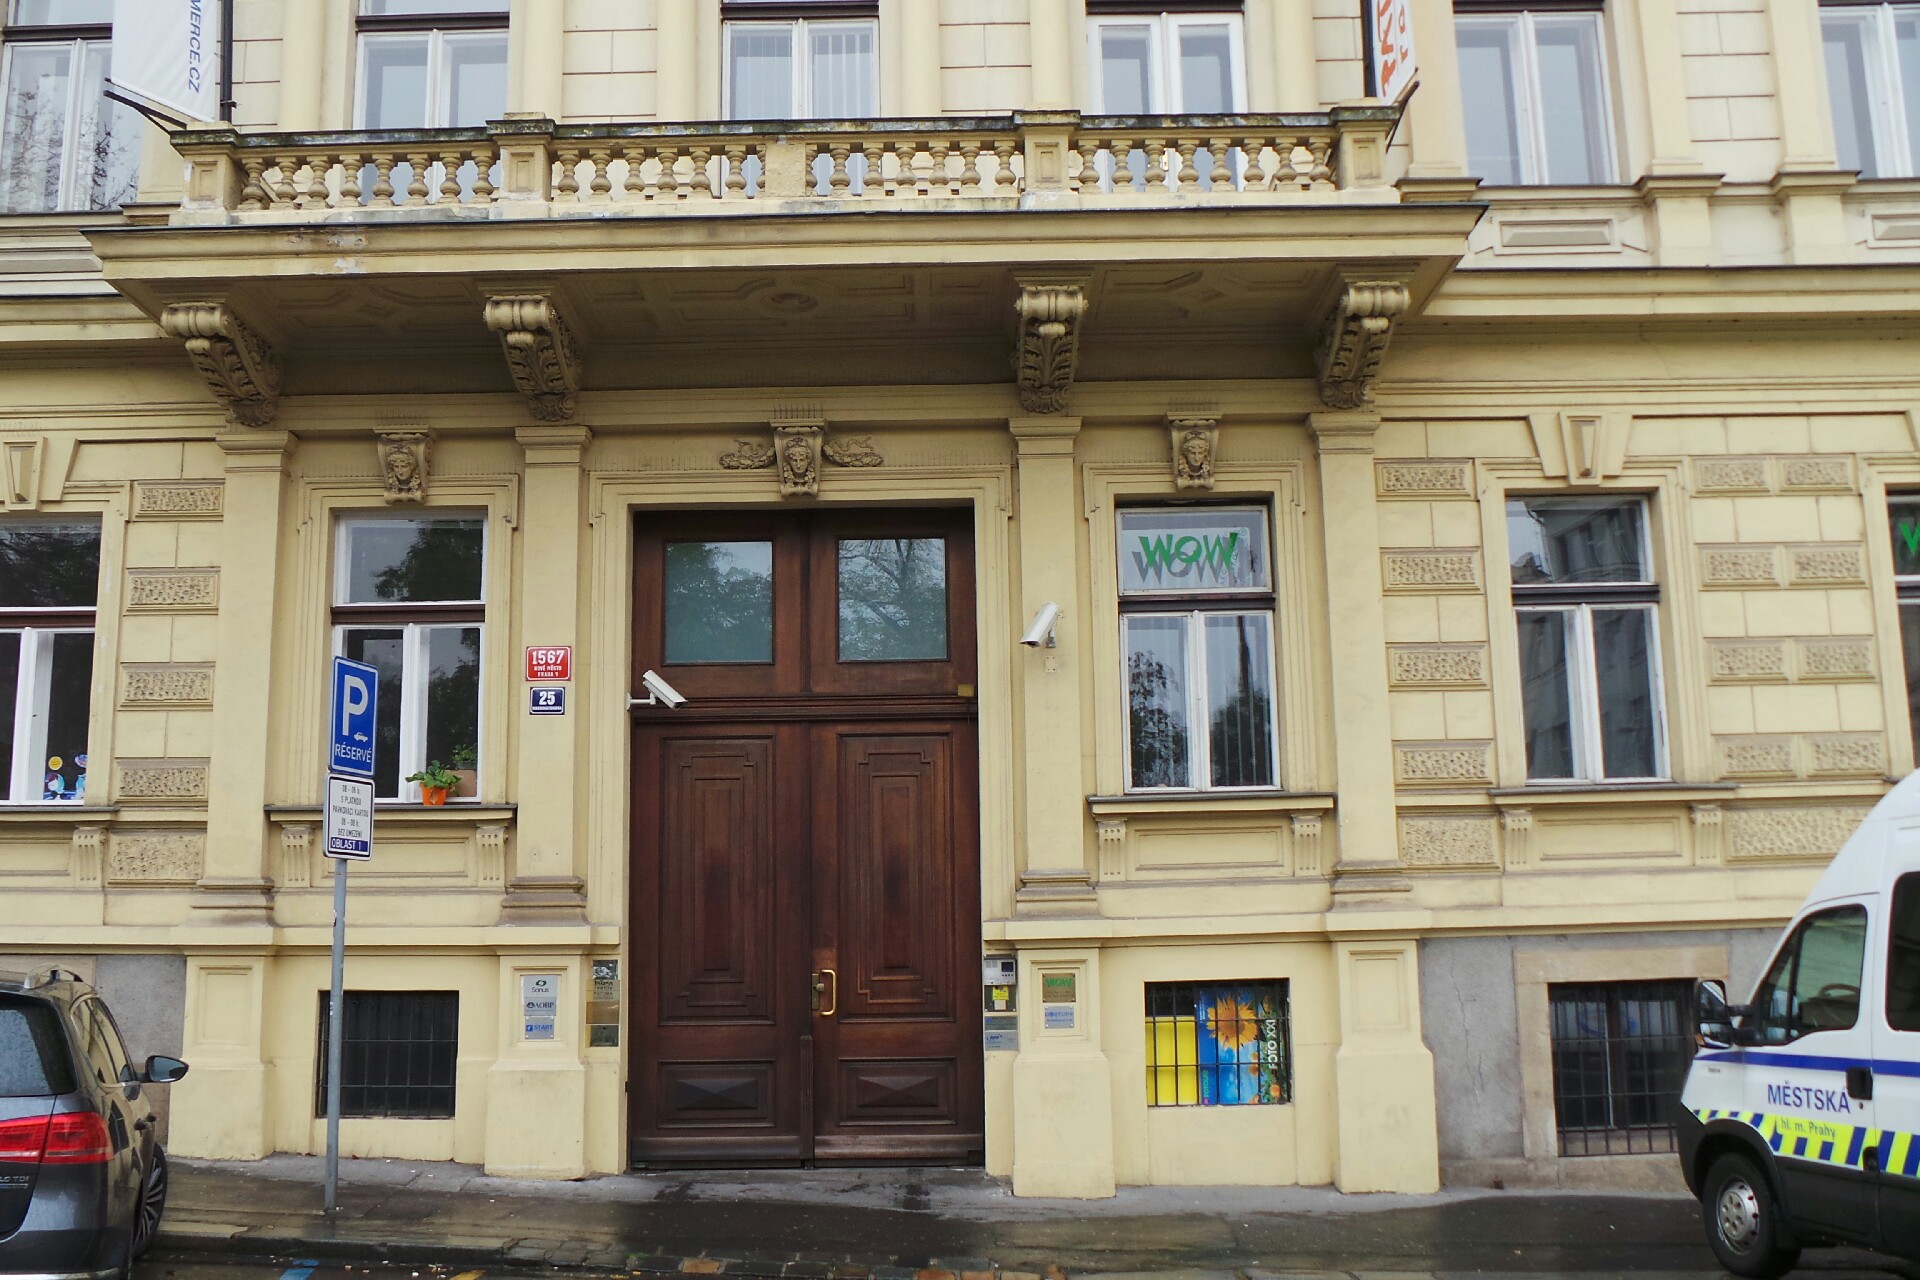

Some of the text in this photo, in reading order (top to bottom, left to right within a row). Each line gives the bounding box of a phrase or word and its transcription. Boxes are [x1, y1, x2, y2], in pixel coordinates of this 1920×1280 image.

[1138, 532, 1239, 569] WOW
[532, 650, 564, 664] 1567
[342, 674, 369, 737] P
[539, 691, 555, 705] 25
[335, 742, 372, 763] RÉSERVÉ
[331, 838, 356, 850] OBLAST
[1266, 1019, 1278, 1069] FOTO XXI
[1767, 1080, 1851, 1114] MĚSTSKÁ
[1809, 1122, 1837, 1140] Prahy
